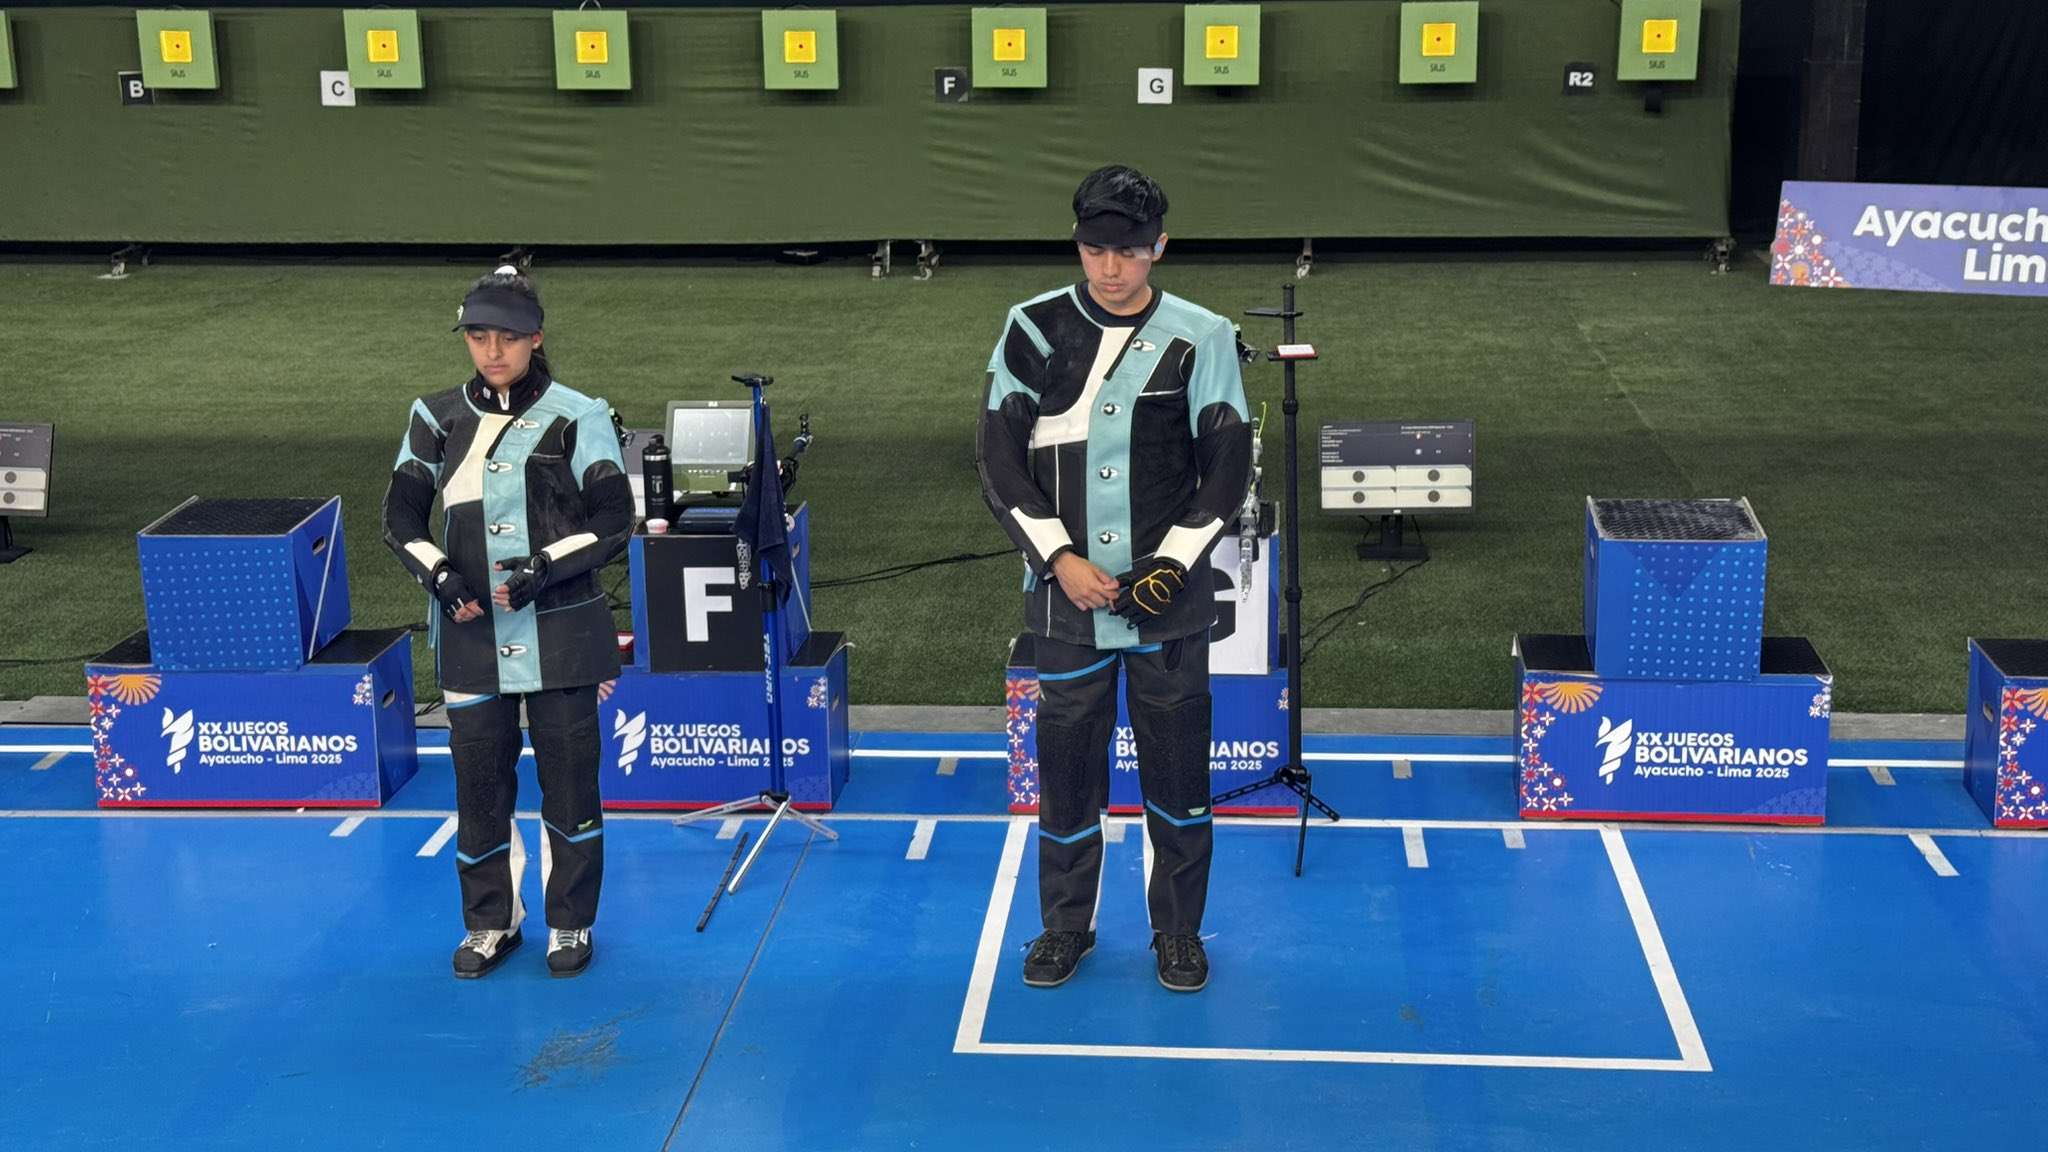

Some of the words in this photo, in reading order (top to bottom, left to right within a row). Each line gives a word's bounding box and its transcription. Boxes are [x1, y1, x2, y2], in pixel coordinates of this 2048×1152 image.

[943, 76, 956, 95] F
[1149, 78, 1164, 94] G
[1569, 71, 1594, 87] R2
[129, 80, 144, 98] B
[331, 80, 345, 97] C
[1963, 242, 2047, 283] Lim
[683, 567, 736, 642] F
[198, 722, 222, 735] XX
[224, 722, 289, 735] JUEGOS
[650, 724, 675, 737] XX
[676, 724, 741, 737] JUEGOS
[198, 735, 358, 753] BOLIVARIANOS
[1636, 732, 1662, 746] XX
[1664, 732, 1735, 747] JUEGOS
[199, 753, 264, 767] Ayacucho
[276, 752, 308, 764] Lima
[311, 753, 343, 764] 2025
[650, 755, 716, 769] Ayacucho
[727, 755, 760, 767] Lima
[1634, 746, 1809, 766] BOLIVARIANOS
[1230, 760, 1263, 771] 2025
[1634, 765, 1704, 779] Ayacucho
[1717, 766, 1752, 778] Lima
[1755, 767, 1790, 779] 2025
